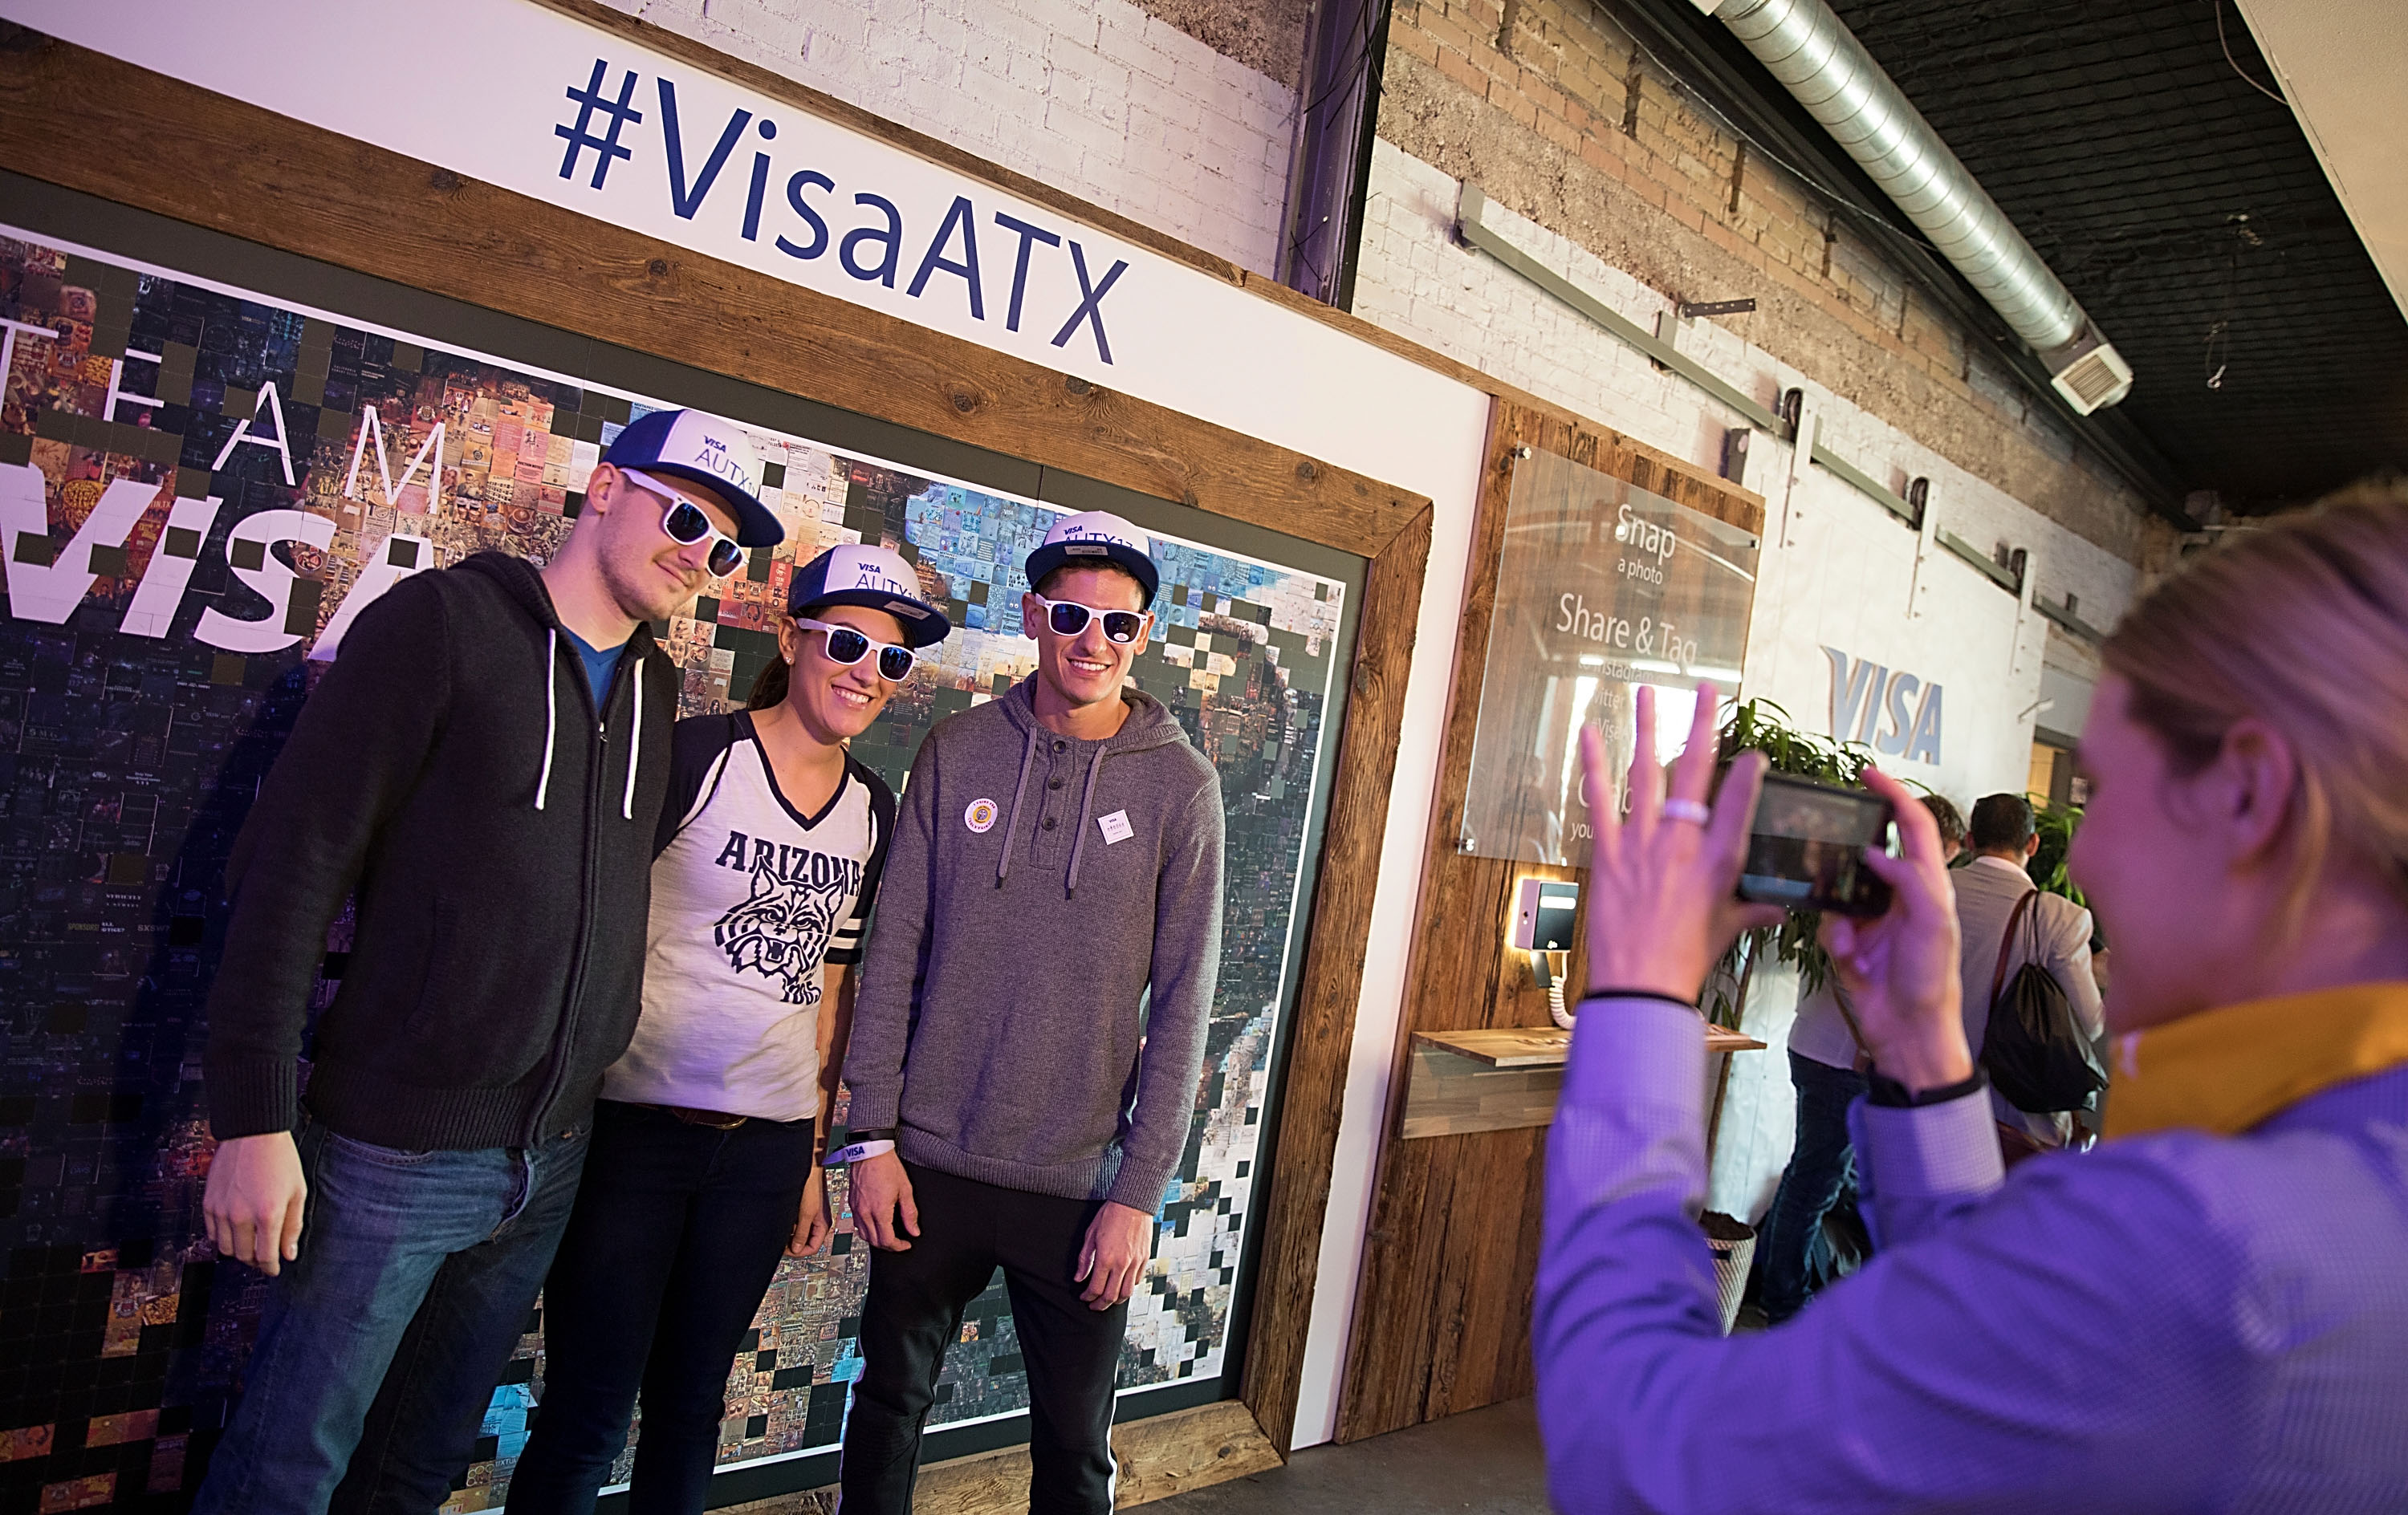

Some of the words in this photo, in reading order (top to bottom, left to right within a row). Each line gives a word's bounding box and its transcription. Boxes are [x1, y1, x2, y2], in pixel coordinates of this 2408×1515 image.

[555, 59, 1129, 365] #VisaATX
[704, 435, 726, 453] VISA
[1064, 525, 1083, 535] VISA
[1615, 504, 1676, 566] Snap
[857, 563, 881, 574] VISA
[1617, 558, 1626, 572] a
[1627, 559, 1663, 585] photo
[1556, 592, 1630, 649] Share
[1635, 616, 1654, 656] &
[1659, 621, 1698, 667] Tag
[1819, 644, 1943, 766] VISA
[1570, 822, 1595, 842] you
[715, 831, 861, 898] ARIZONA
[845, 1146, 864, 1157] VISA
